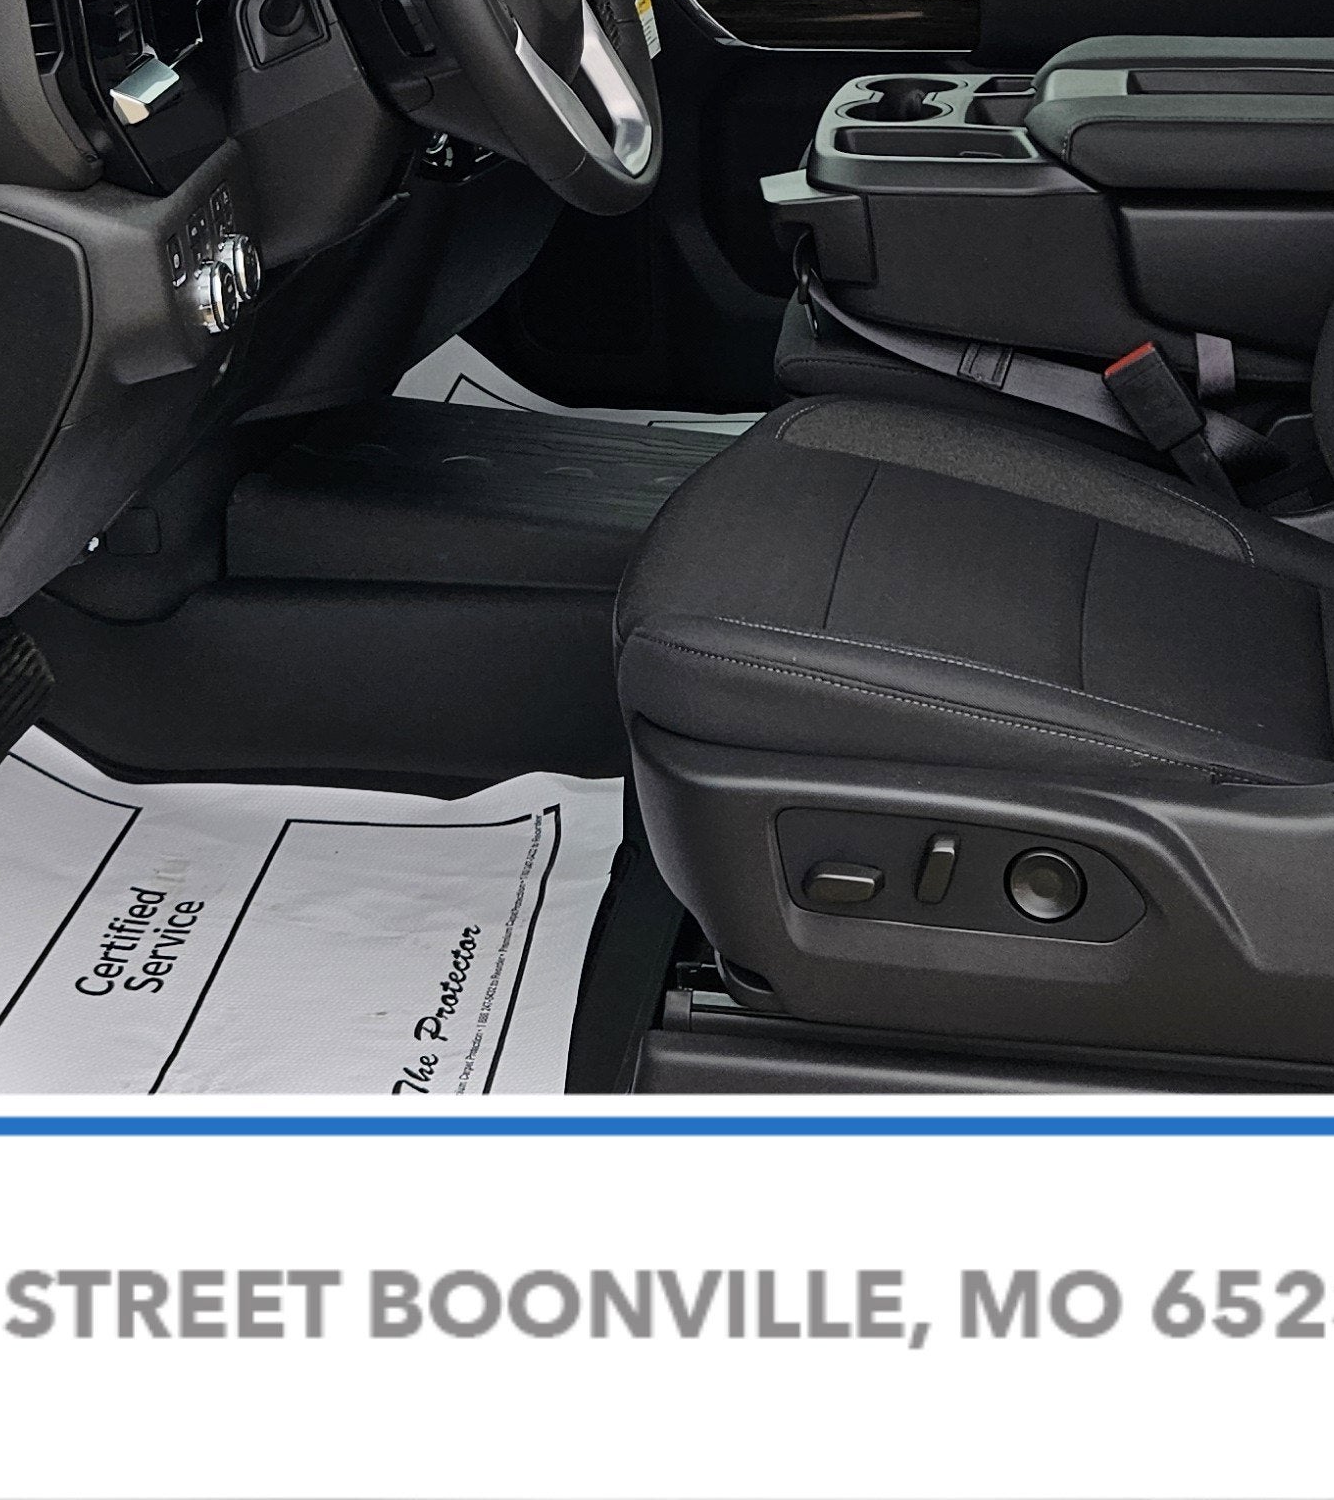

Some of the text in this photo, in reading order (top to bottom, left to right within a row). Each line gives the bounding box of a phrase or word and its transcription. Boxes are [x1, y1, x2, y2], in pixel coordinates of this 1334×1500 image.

[75, 886, 167, 996] Certified
[123, 901, 205, 993] Service
[392, 924, 481, 1094] The Protector
